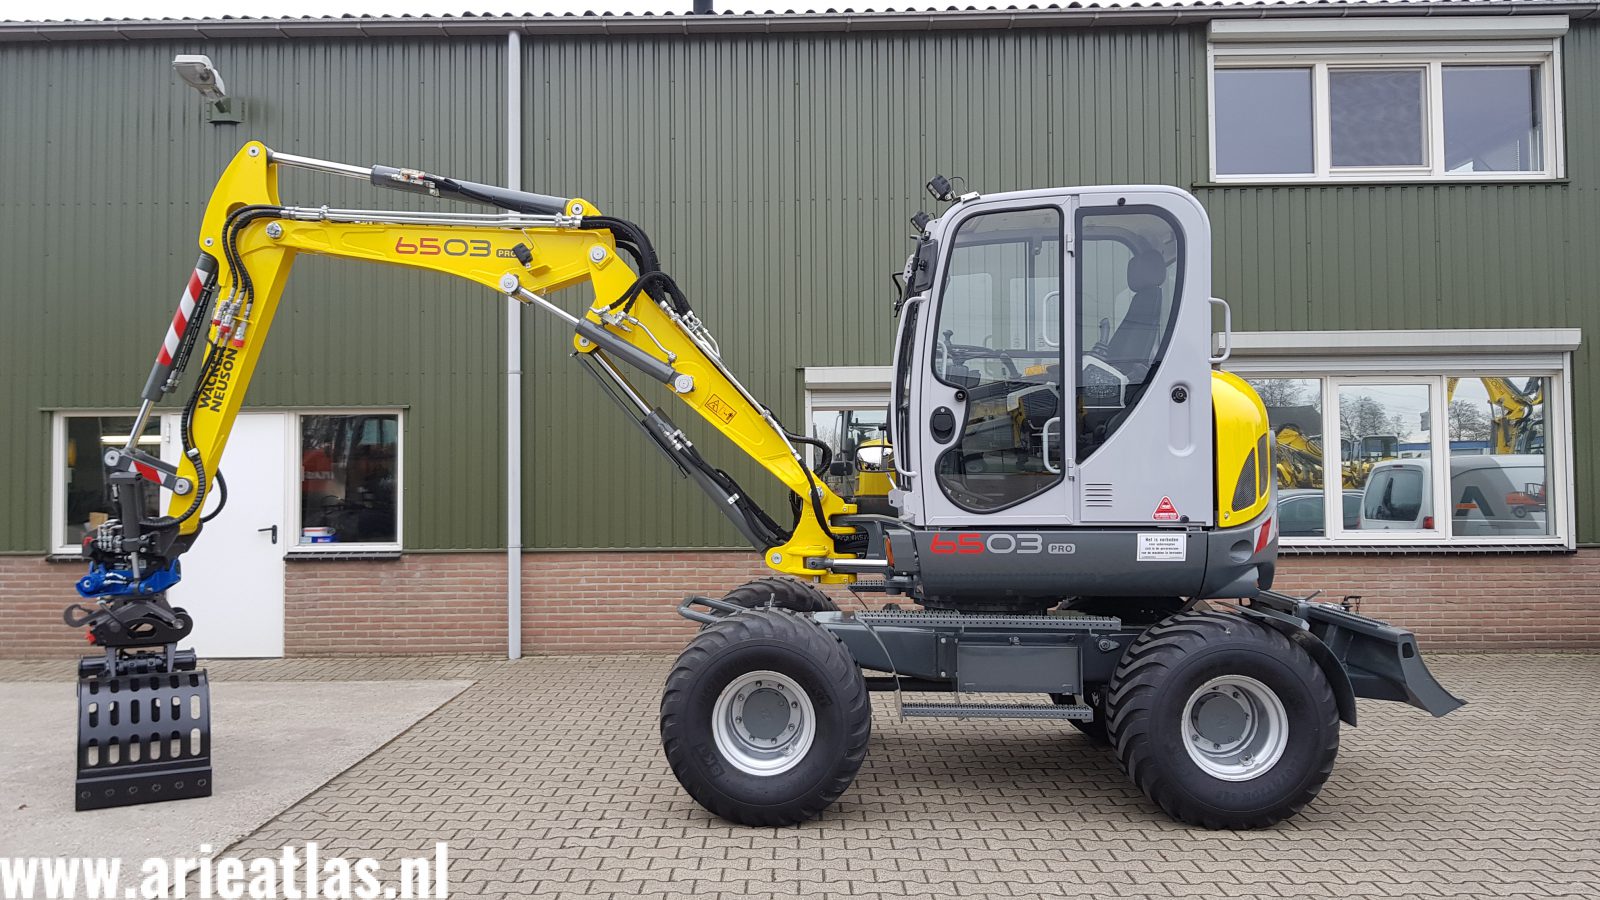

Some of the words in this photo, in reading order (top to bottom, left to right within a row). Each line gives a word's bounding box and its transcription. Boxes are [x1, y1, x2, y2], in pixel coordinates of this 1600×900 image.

[395, 236, 491, 257] 6503
[198, 346, 227, 409] WACK
[210, 348, 238, 412] NEUSON
[930, 533, 1042, 554] 6503
[1051, 544, 1073, 553] PRO
